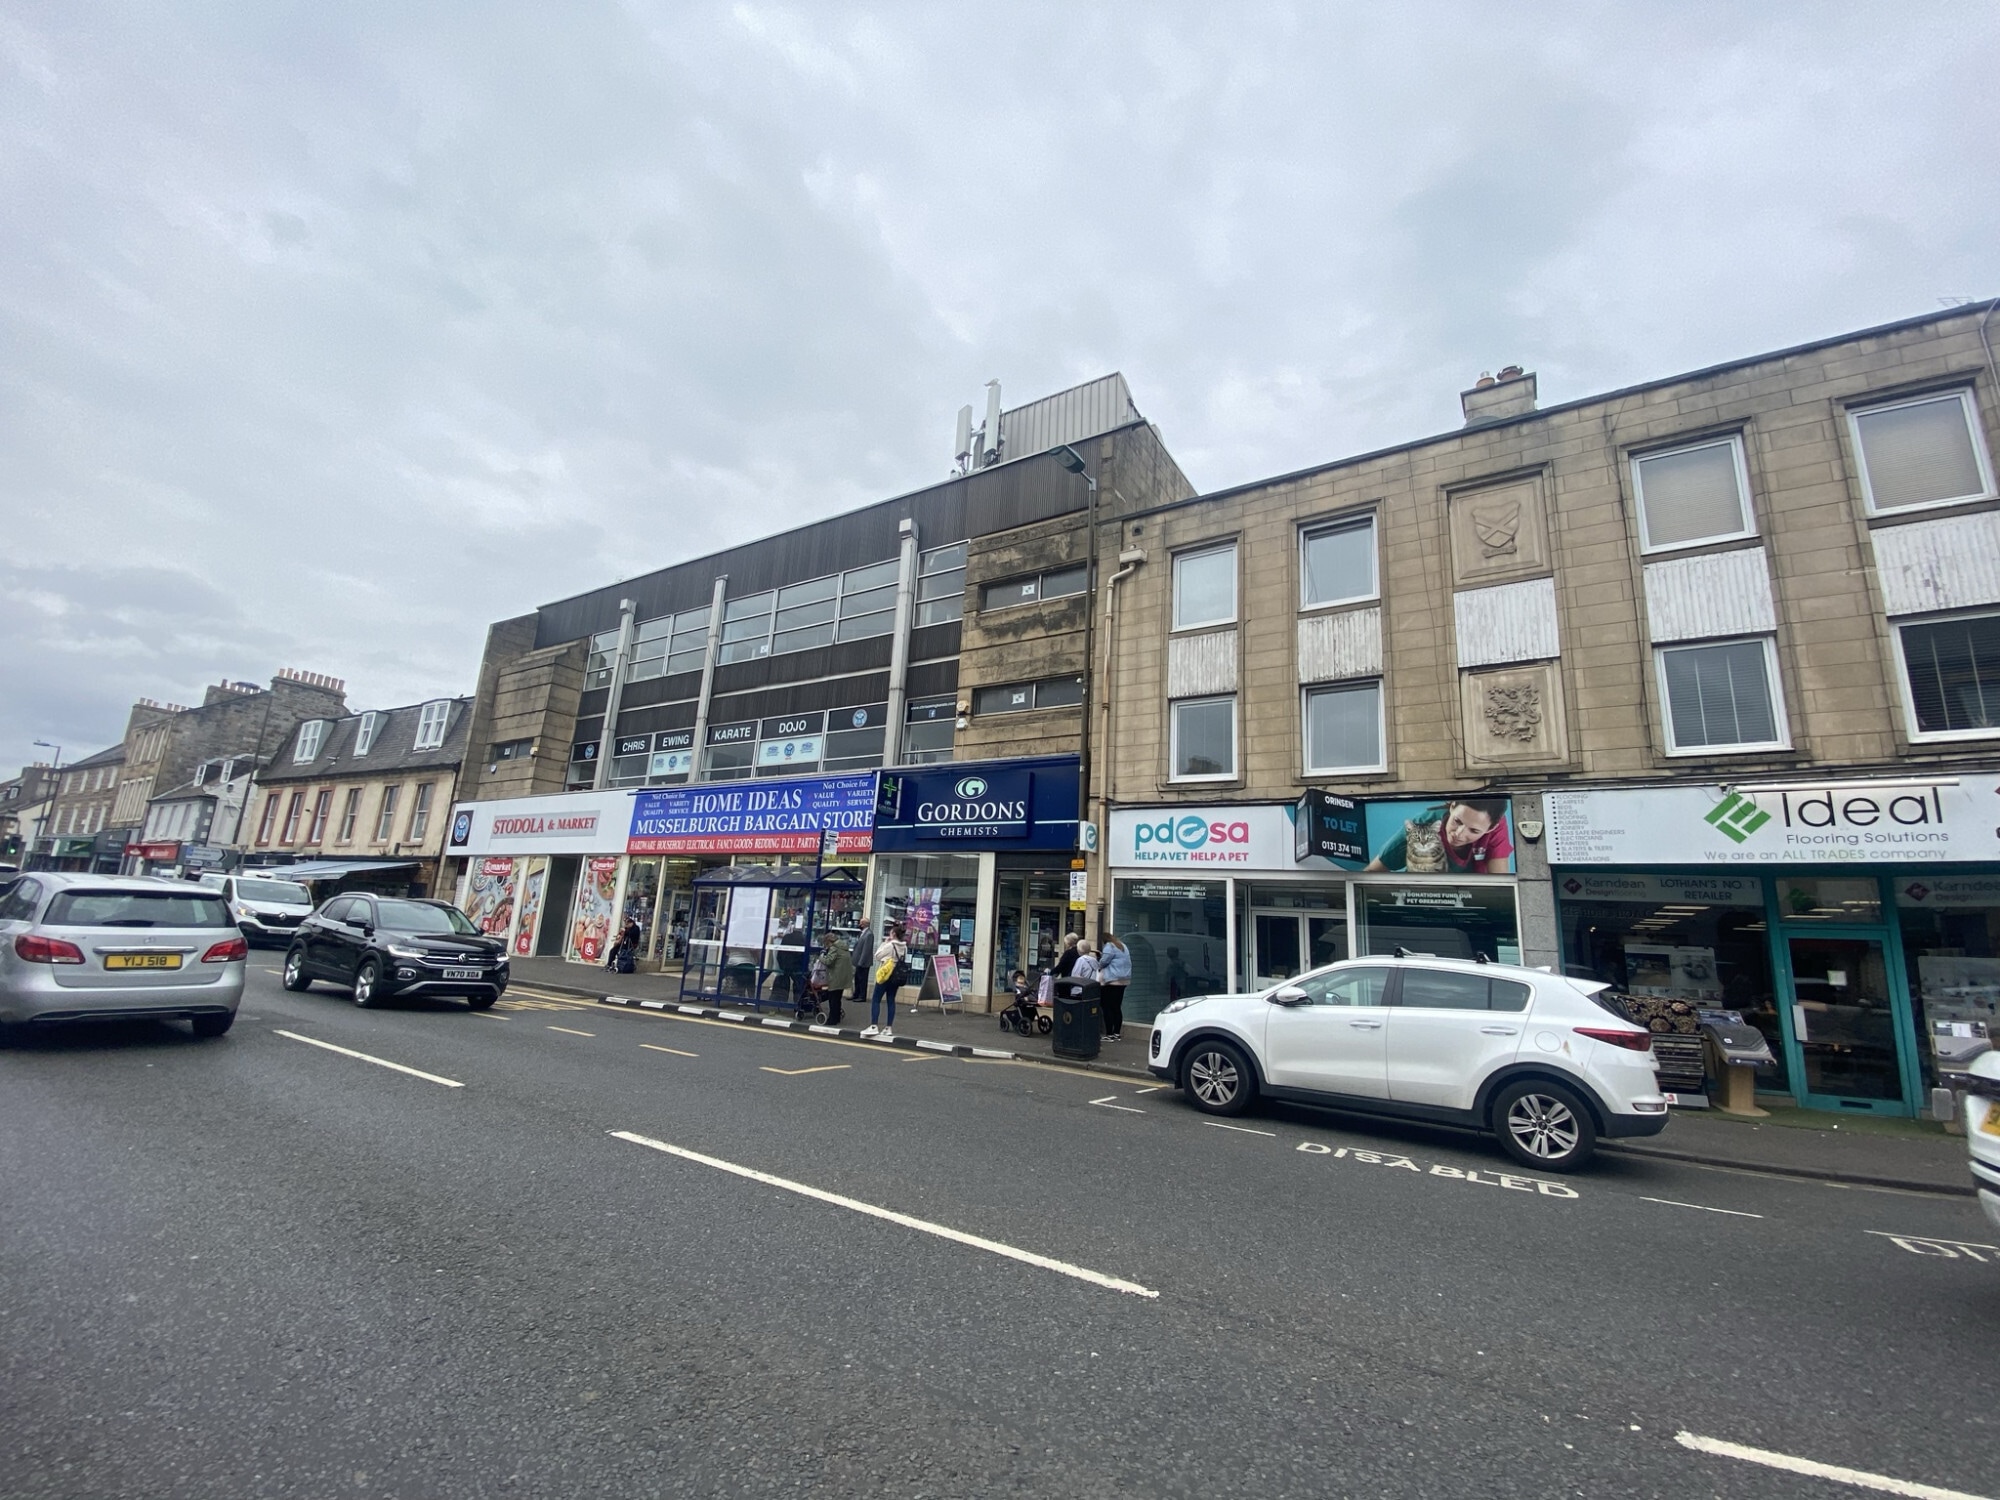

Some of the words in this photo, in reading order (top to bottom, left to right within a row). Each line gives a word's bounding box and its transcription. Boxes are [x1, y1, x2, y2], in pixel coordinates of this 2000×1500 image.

[622, 740, 645, 752] CHRIS
[662, 734, 690, 747] EWING
[714, 727, 752, 740] KARATE
[778, 720, 807, 734] DOJO
[837, 780, 858, 789] Choice
[692, 792, 742, 813] HOME
[746, 789, 802, 811] IDEAS
[812, 800, 840, 808] QUALITY
[1324, 796, 1354, 809] ORINSEN
[1782, 786, 1943, 828] Ideal
[918, 801, 1025, 822] GORDONS
[493, 818, 544, 834] STODOLA
[548, 821, 554, 830] &
[557, 818, 596, 830] MARKET
[635, 816, 744, 834] MUSSELBURGH
[744, 812, 820, 831] BARGAIN
[822, 810, 872, 829] STORE
[1323, 816, 1338, 830] TO
[1340, 819, 1358, 833] LET
[940, 826, 998, 836] CHEMISTS
[630, 840, 656, 850] HARDWARE
[656, 840, 686, 850] HOUSEHOLD
[686, 840, 715, 850] ELECTRICAL
[716, 839, 733, 849] FANCY
[734, 839, 753, 849] GOODS
[797, 837, 814, 848] PARTY
[1787, 833, 1858, 845] Flooring
[1864, 832, 1949, 843] Solutions
[1322, 841, 1336, 851] 0131
[1338, 842, 1350, 852] 374
[1135, 852, 1158, 860] HELP
[1160, 852, 1167, 860] A
[1168, 852, 1188, 860] VET
[1191, 852, 1216, 861] HELP
[1218, 852, 1225, 861] A
[1228, 852, 1249, 861] PET
[1704, 851, 1727, 860] We
[1730, 852, 1756, 860] are
[1760, 852, 1779, 860] an
[1782, 850, 1806, 860] ALL
[1810, 850, 1865, 859] TRADES
[1870, 849, 1946, 860] company
[1584, 878, 1645, 889] Karndean
[1660, 879, 1718, 889] LOTHIAN'S
[1684, 890, 1732, 900] RETAILER
[147, 956, 167, 966] 518
[1296, 1142, 1579, 1198] DISABLED
